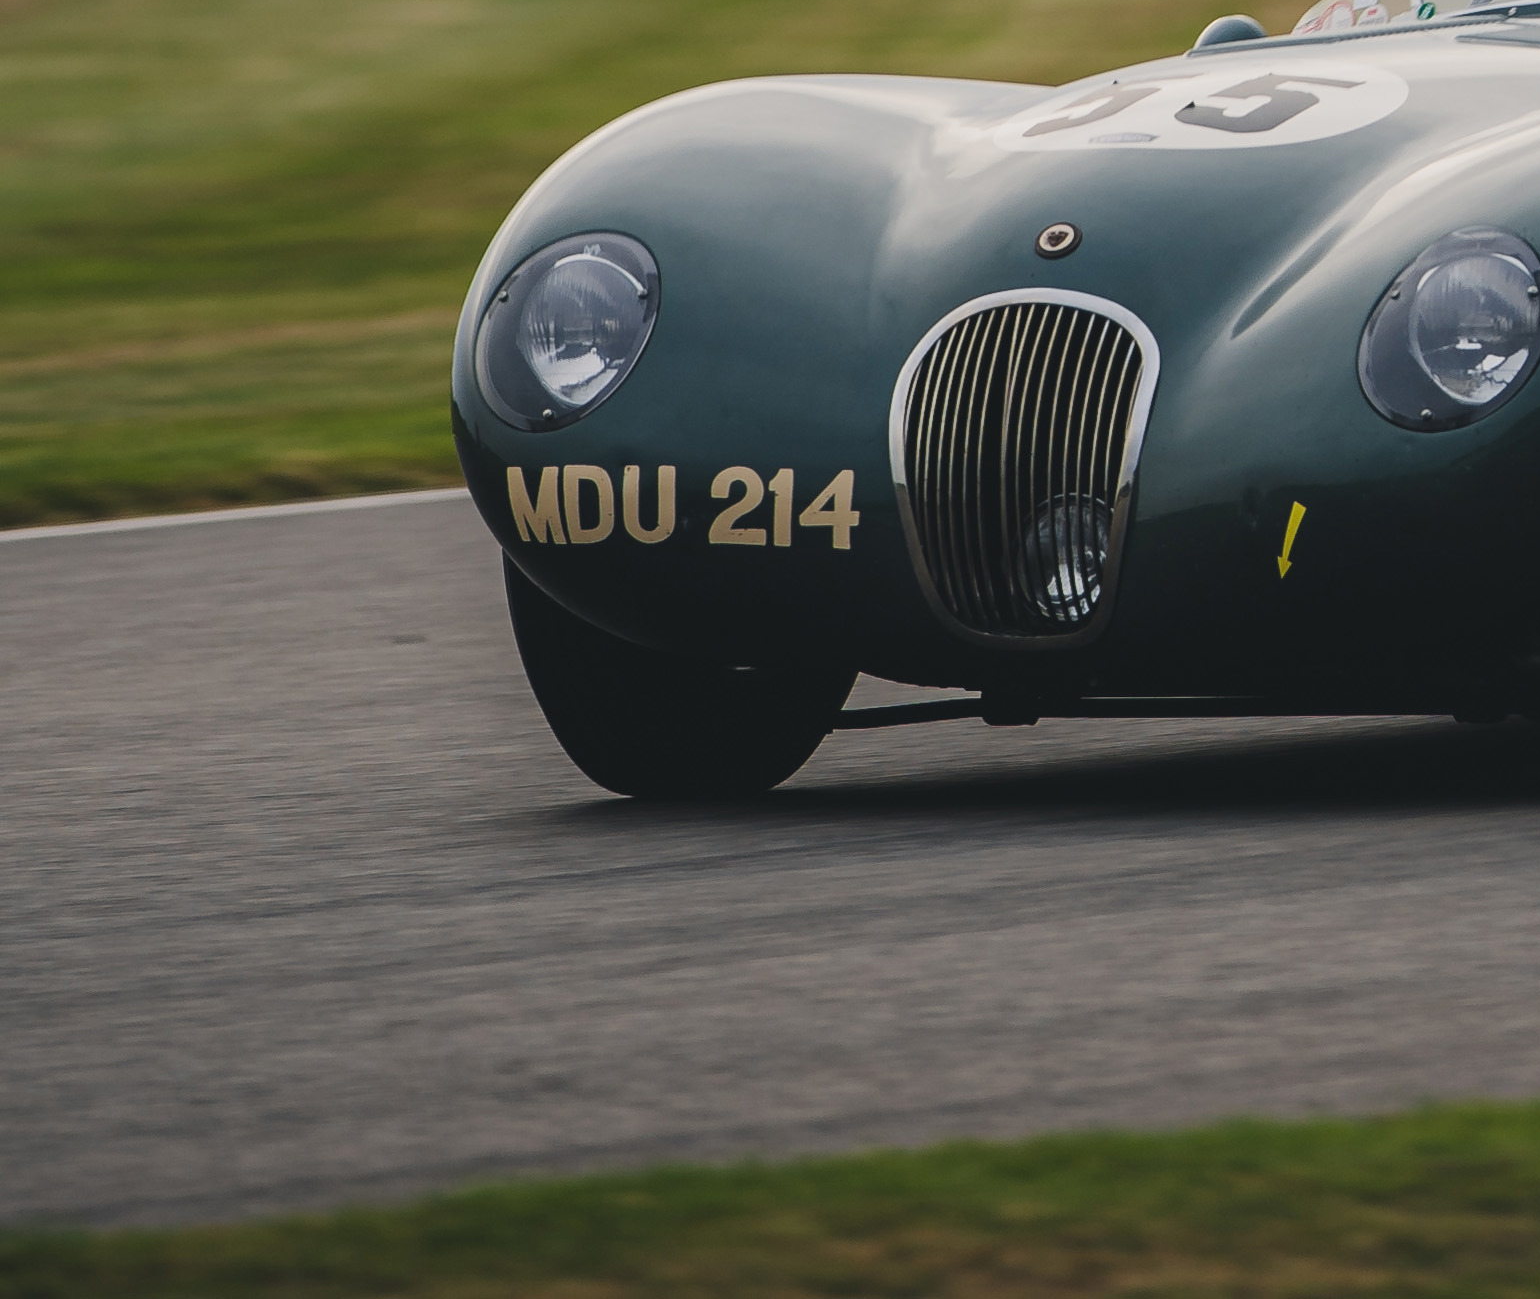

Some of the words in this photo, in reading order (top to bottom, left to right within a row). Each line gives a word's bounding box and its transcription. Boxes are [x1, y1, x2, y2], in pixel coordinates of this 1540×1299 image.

[1022, 73, 1367, 136] 55
[506, 464, 676, 545] MDU
[709, 466, 860, 551] 214
